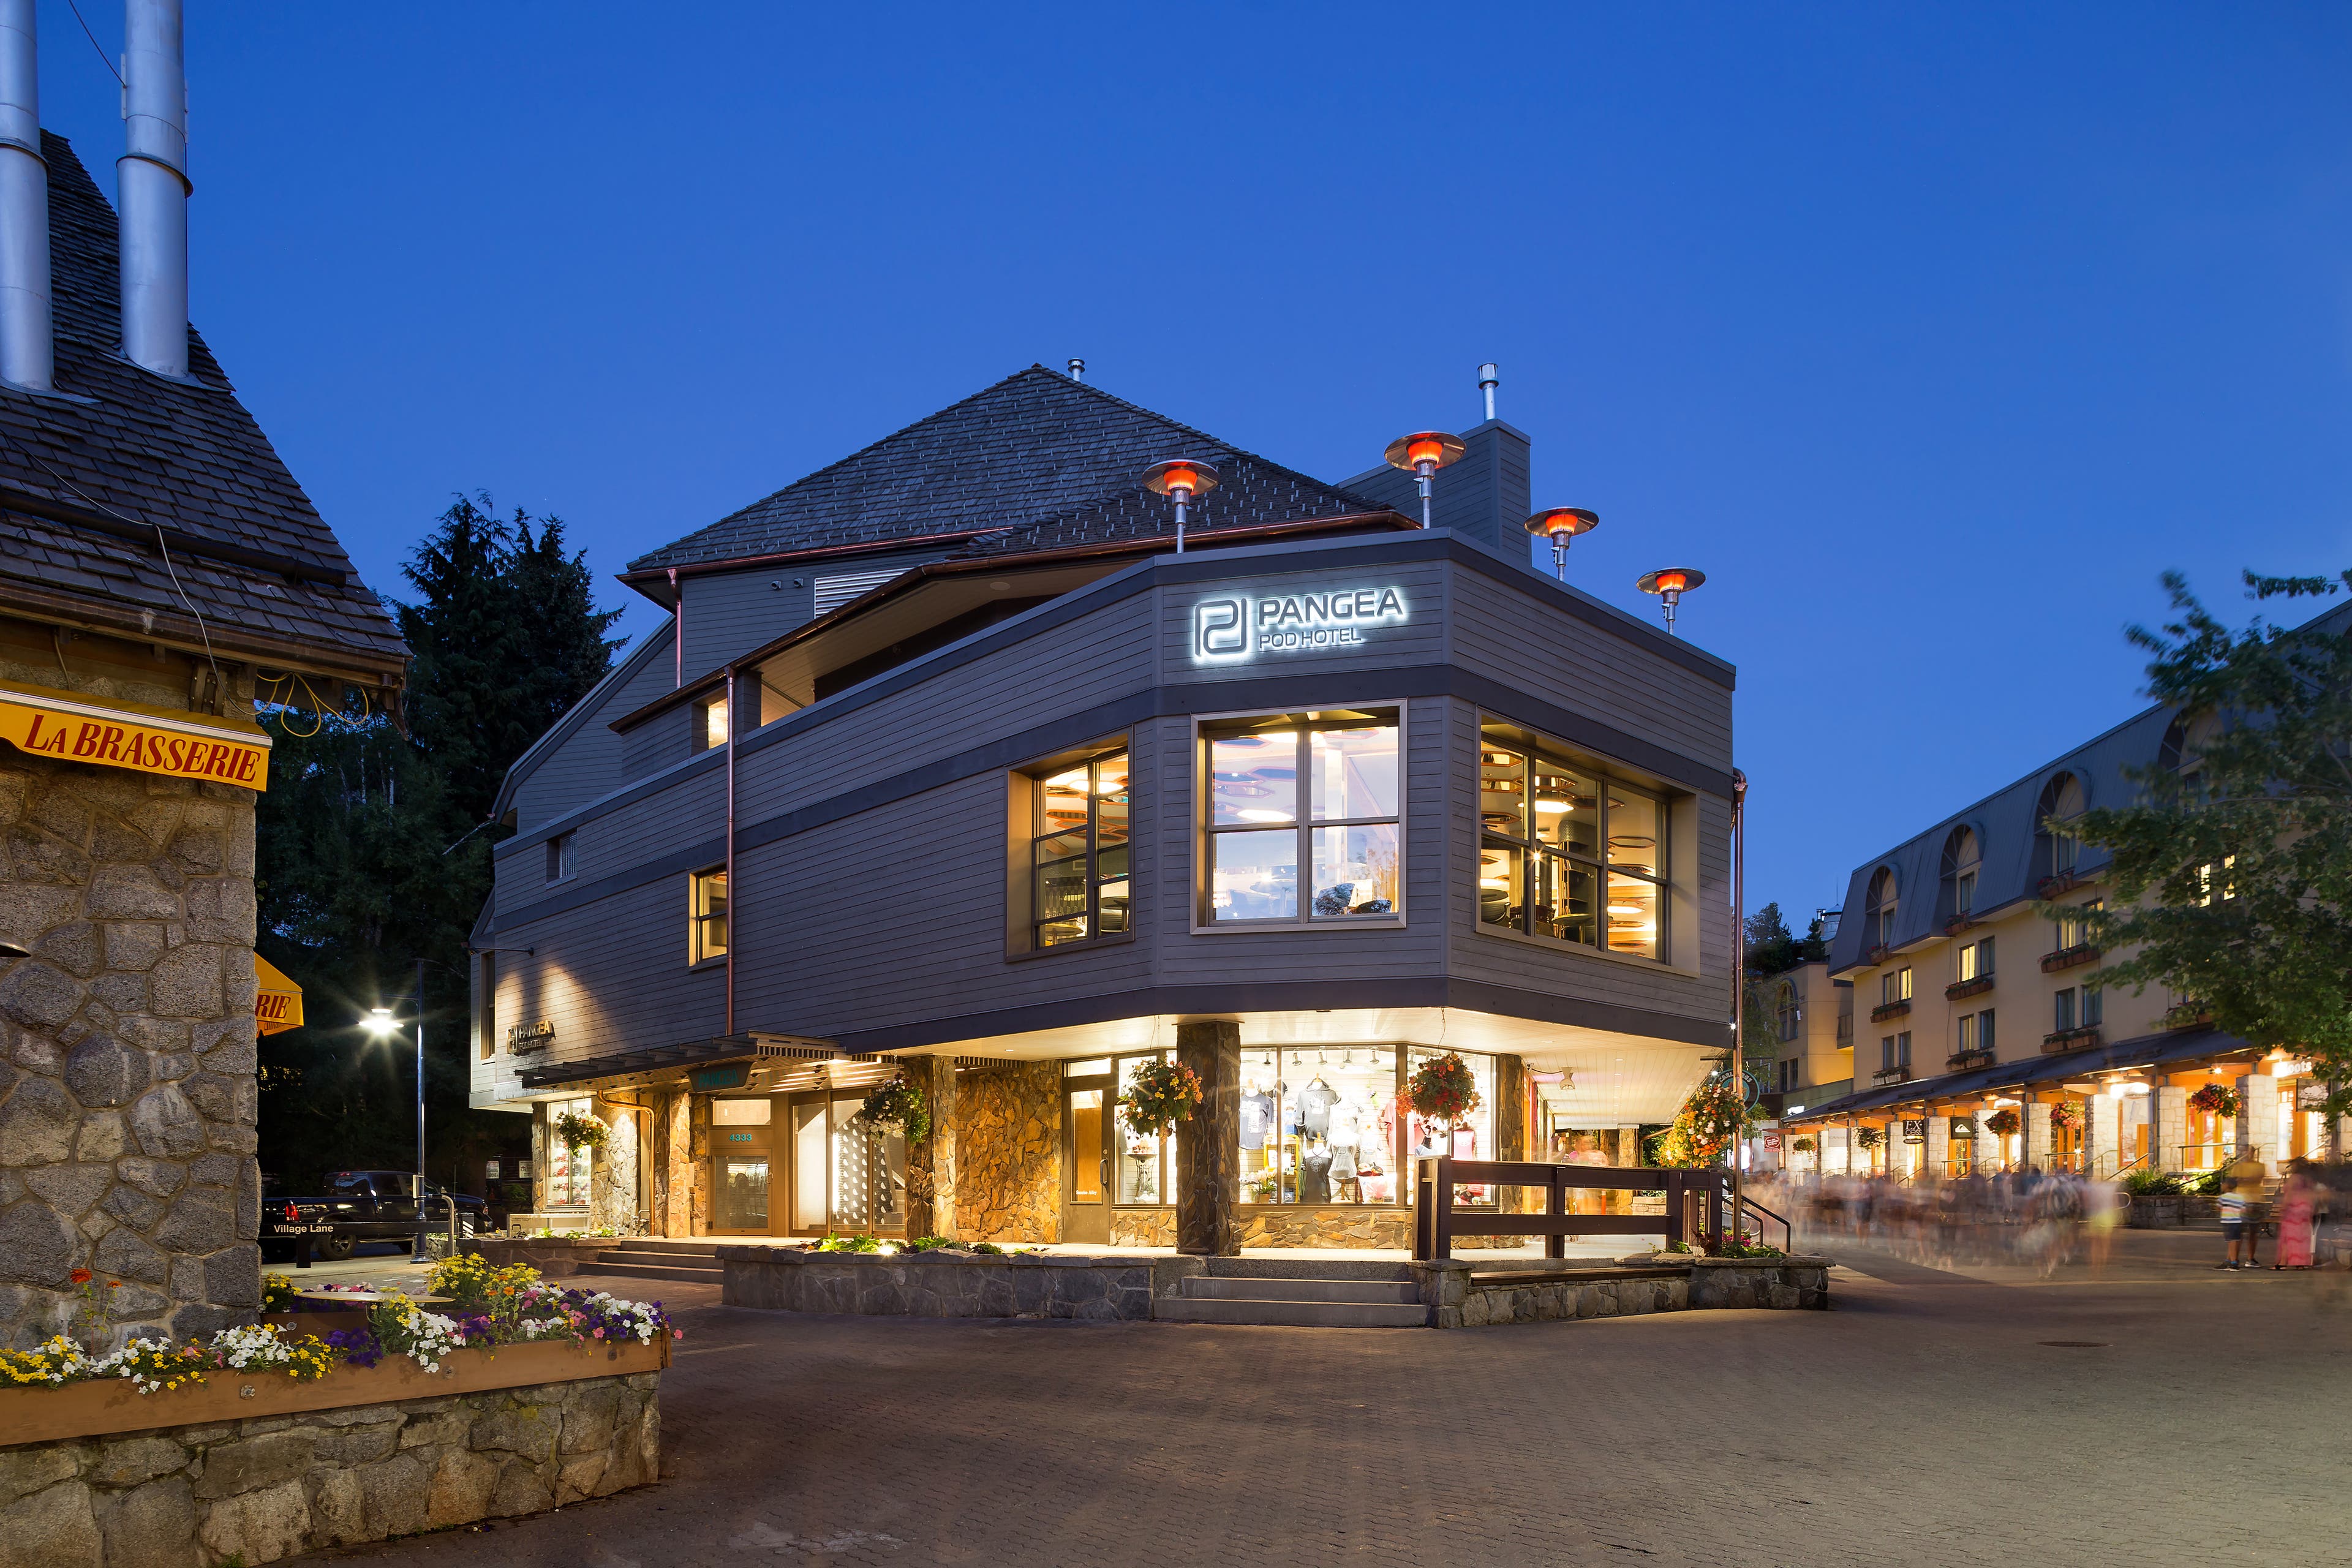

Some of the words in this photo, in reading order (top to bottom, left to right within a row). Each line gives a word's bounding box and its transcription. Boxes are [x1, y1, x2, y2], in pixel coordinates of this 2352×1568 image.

[1259, 589, 1403, 627] PANGEA
[1259, 632, 1297, 649] POD
[1302, 627, 1361, 646] HOTEL
[72, 722, 261, 782] BRASSERIE
[519, 1019, 551, 1039] PANGEA
[698, 1069, 739, 1088] PANGEA
[274, 1225, 307, 1235] Village
